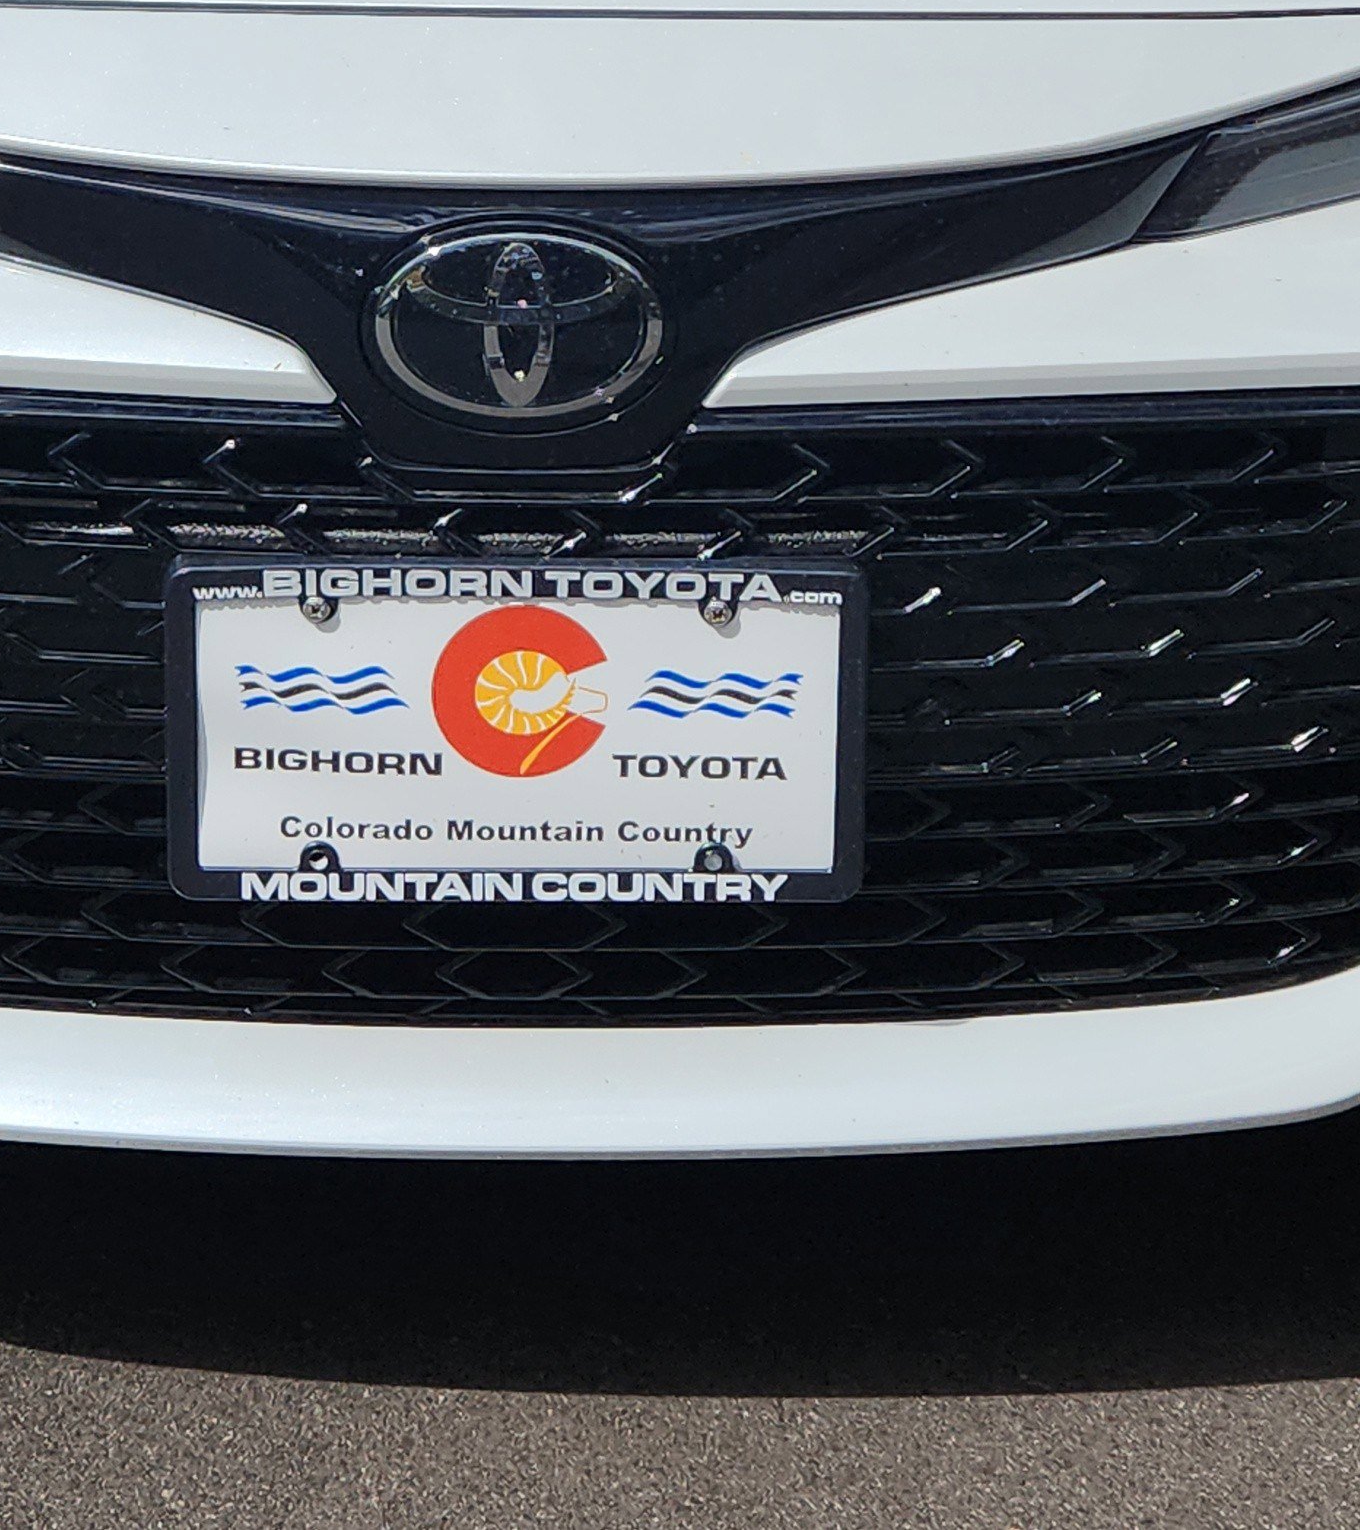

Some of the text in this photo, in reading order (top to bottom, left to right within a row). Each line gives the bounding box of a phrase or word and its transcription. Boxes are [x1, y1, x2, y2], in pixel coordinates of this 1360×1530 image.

[234, 747, 788, 781] BIGHORN TOYOTA
[280, 816, 753, 849] Colorado Mountain Country
[241, 872, 788, 903] MOUNTAIN COUNTRY
